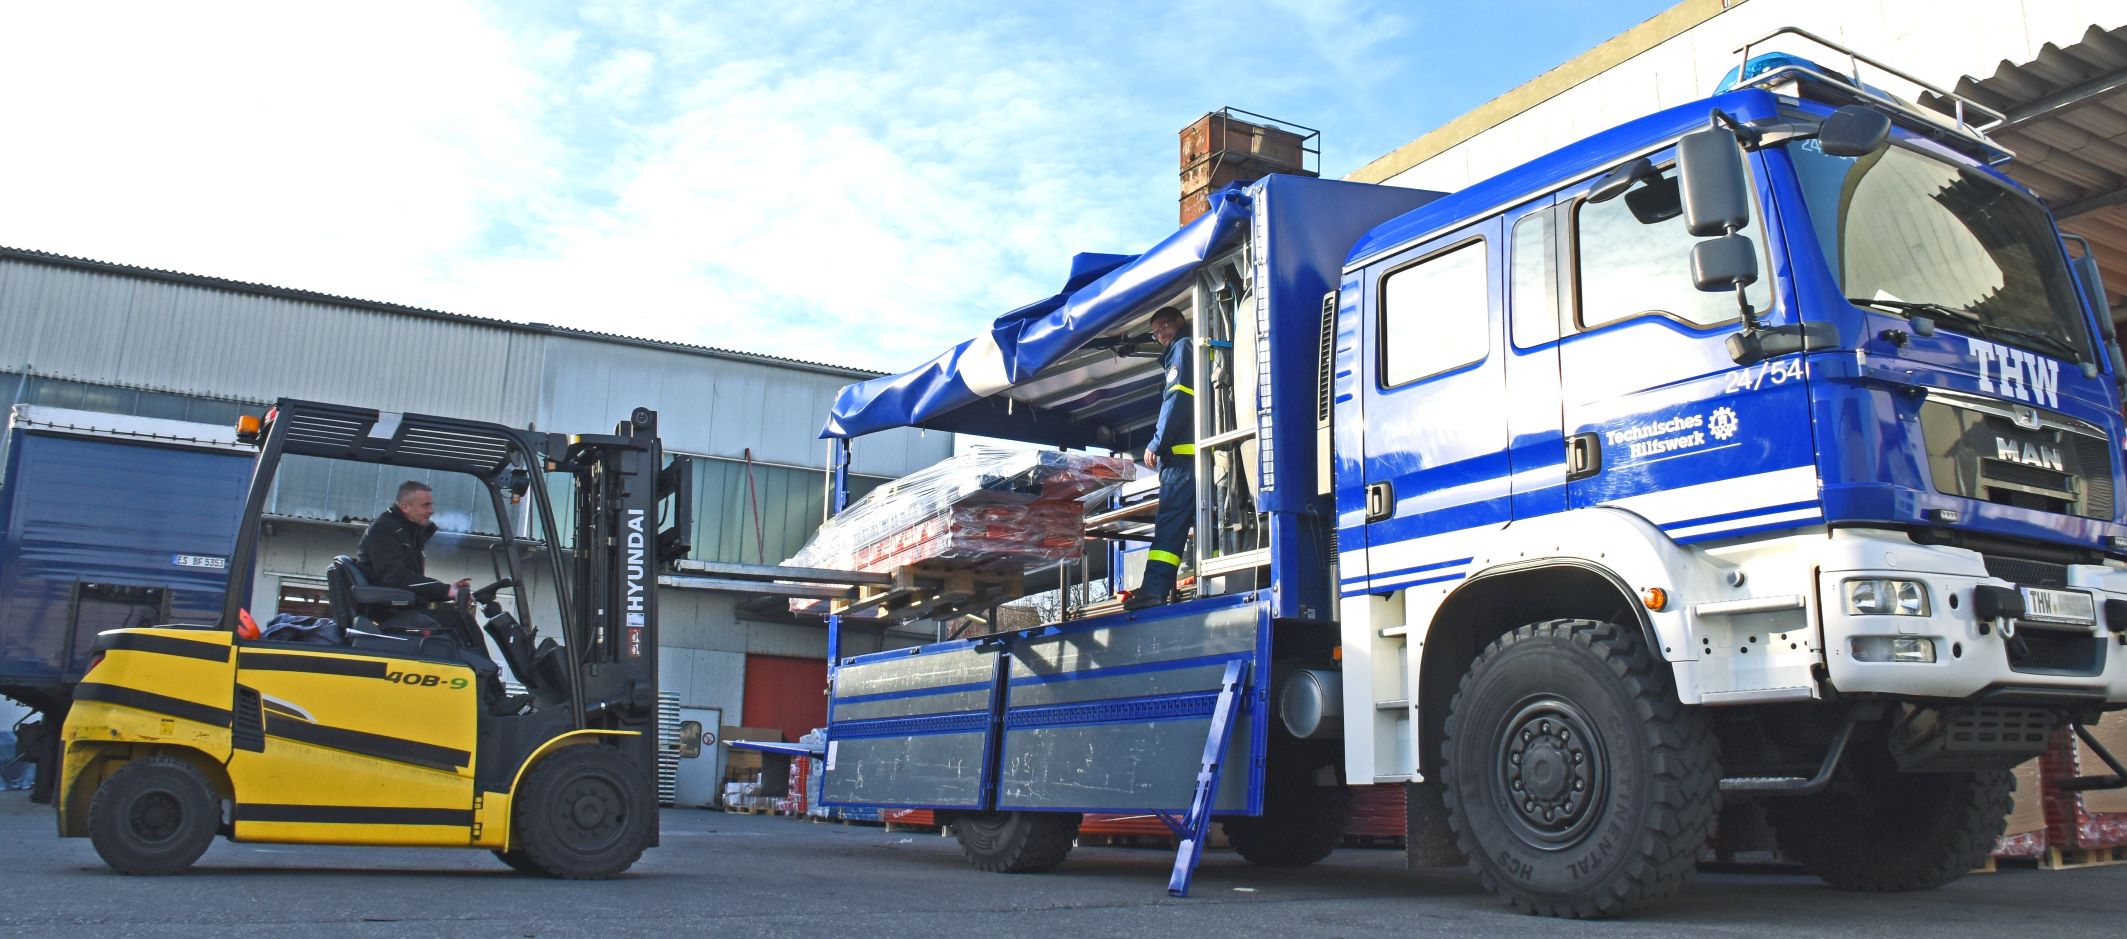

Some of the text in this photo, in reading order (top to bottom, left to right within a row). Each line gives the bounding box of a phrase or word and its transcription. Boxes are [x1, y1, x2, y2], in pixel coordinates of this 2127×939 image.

[1725, 358, 1803, 393] 24/54
[1967, 338, 2060, 409] THW
[1605, 413, 1703, 446] Technisches
[1629, 431, 1705, 459] Hilfswerk
[1996, 437, 2064, 472] MAN
[177, 556, 188, 565] ES
[627, 509, 645, 611] HYUNDAI
[2029, 591, 2052, 614] THW
[384, 671, 469, 690] 40B-9
[1567, 714, 1633, 880] CONTINENTAL
[1498, 850, 1534, 881] HCS
